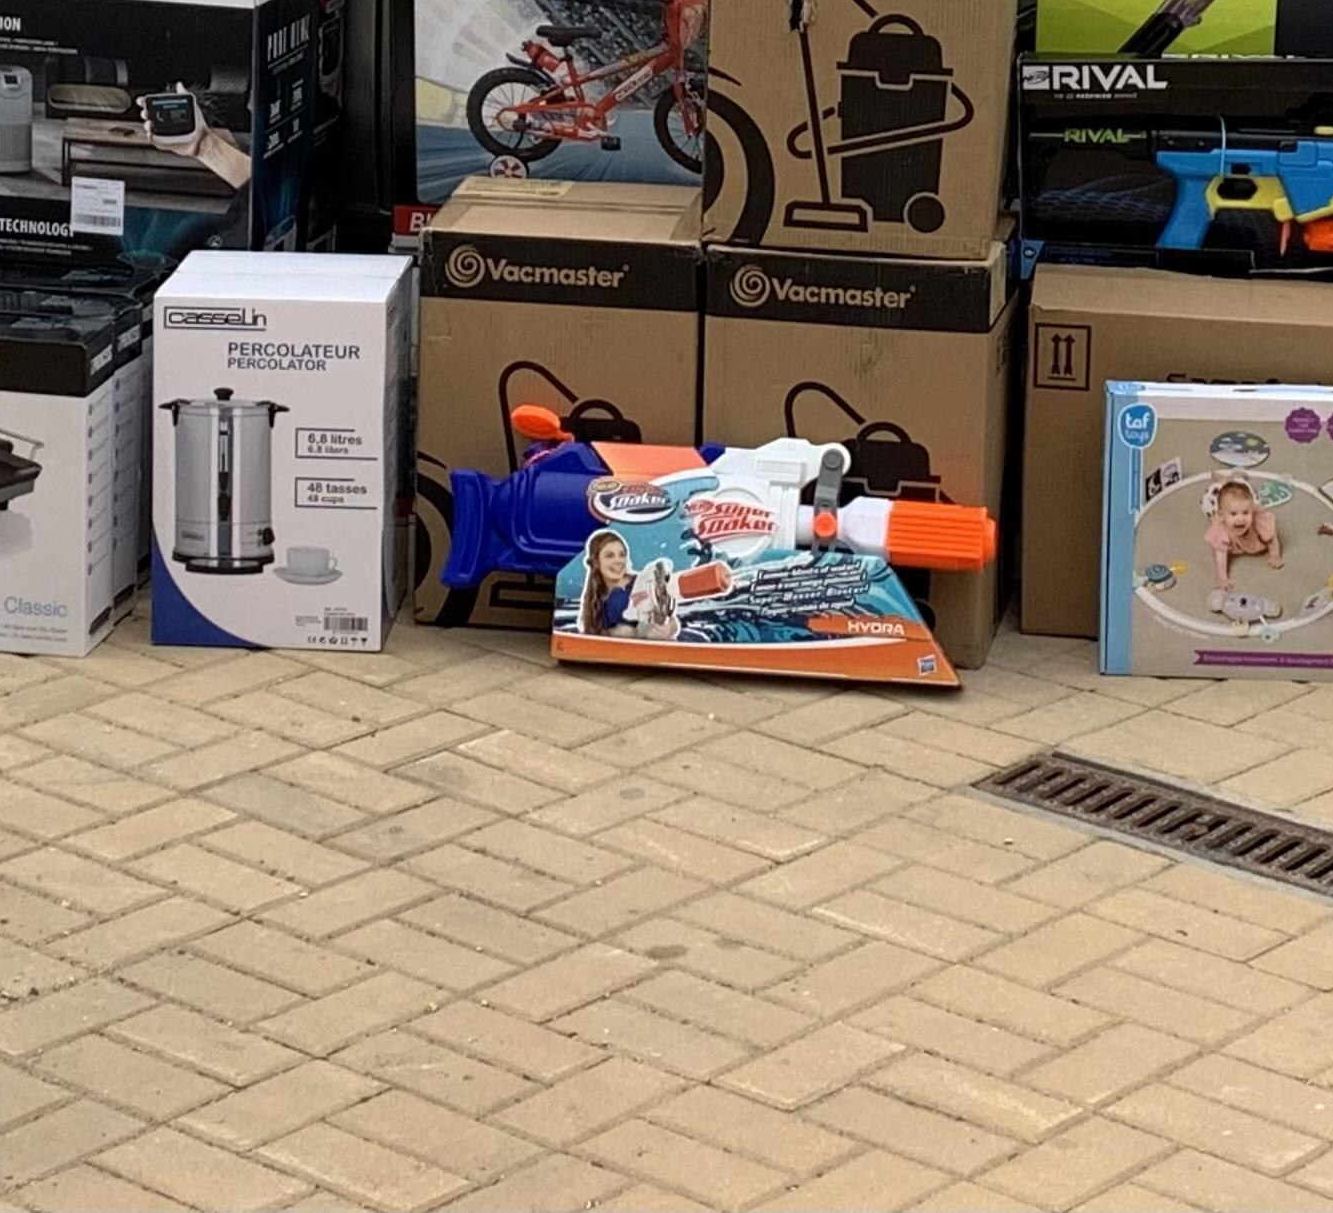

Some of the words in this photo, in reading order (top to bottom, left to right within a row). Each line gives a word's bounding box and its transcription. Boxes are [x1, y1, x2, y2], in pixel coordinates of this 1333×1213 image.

[1052, 64, 1169, 91] RIVAL
[1063, 128, 1130, 144] RIVAL
[0, 217, 75, 237] TECHNOLOGY
[485, 257, 624, 287] Vacmaster
[772, 281, 911, 309] Vacmaster
[227, 342, 361, 360] PERCOLATEUR
[227, 357, 327, 371] PERCOLATOR
[1125, 412, 1151, 429] taf
[330, 434, 362, 445] litres
[307, 482, 323, 493] 48
[325, 483, 367, 494] tasses
[321, 496, 344, 505] cups
[4, 596, 68, 618] Classic
[847, 620, 905, 636] HYDRA
